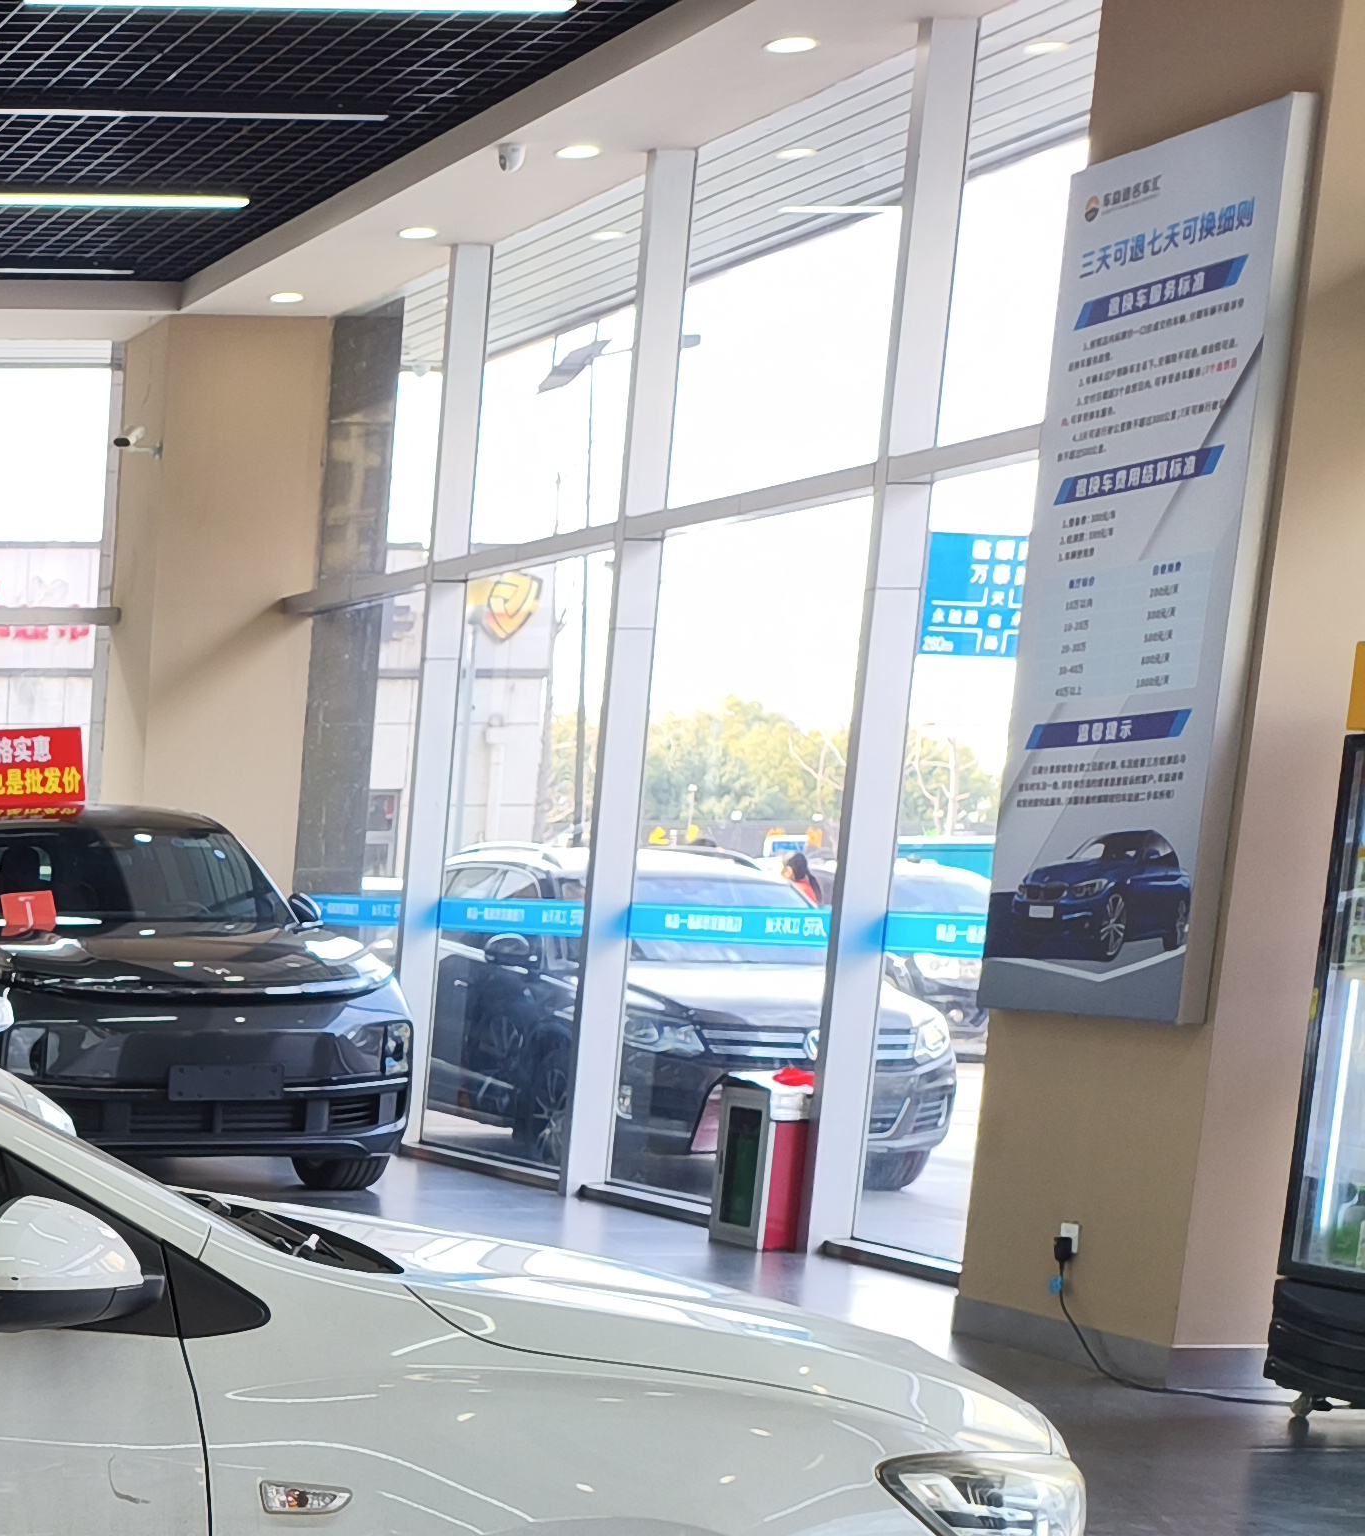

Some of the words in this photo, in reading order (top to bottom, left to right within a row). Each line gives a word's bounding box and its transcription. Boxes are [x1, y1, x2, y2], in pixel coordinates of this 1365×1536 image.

[1078, 195, 1255, 280] 三天可退七天可换细则
